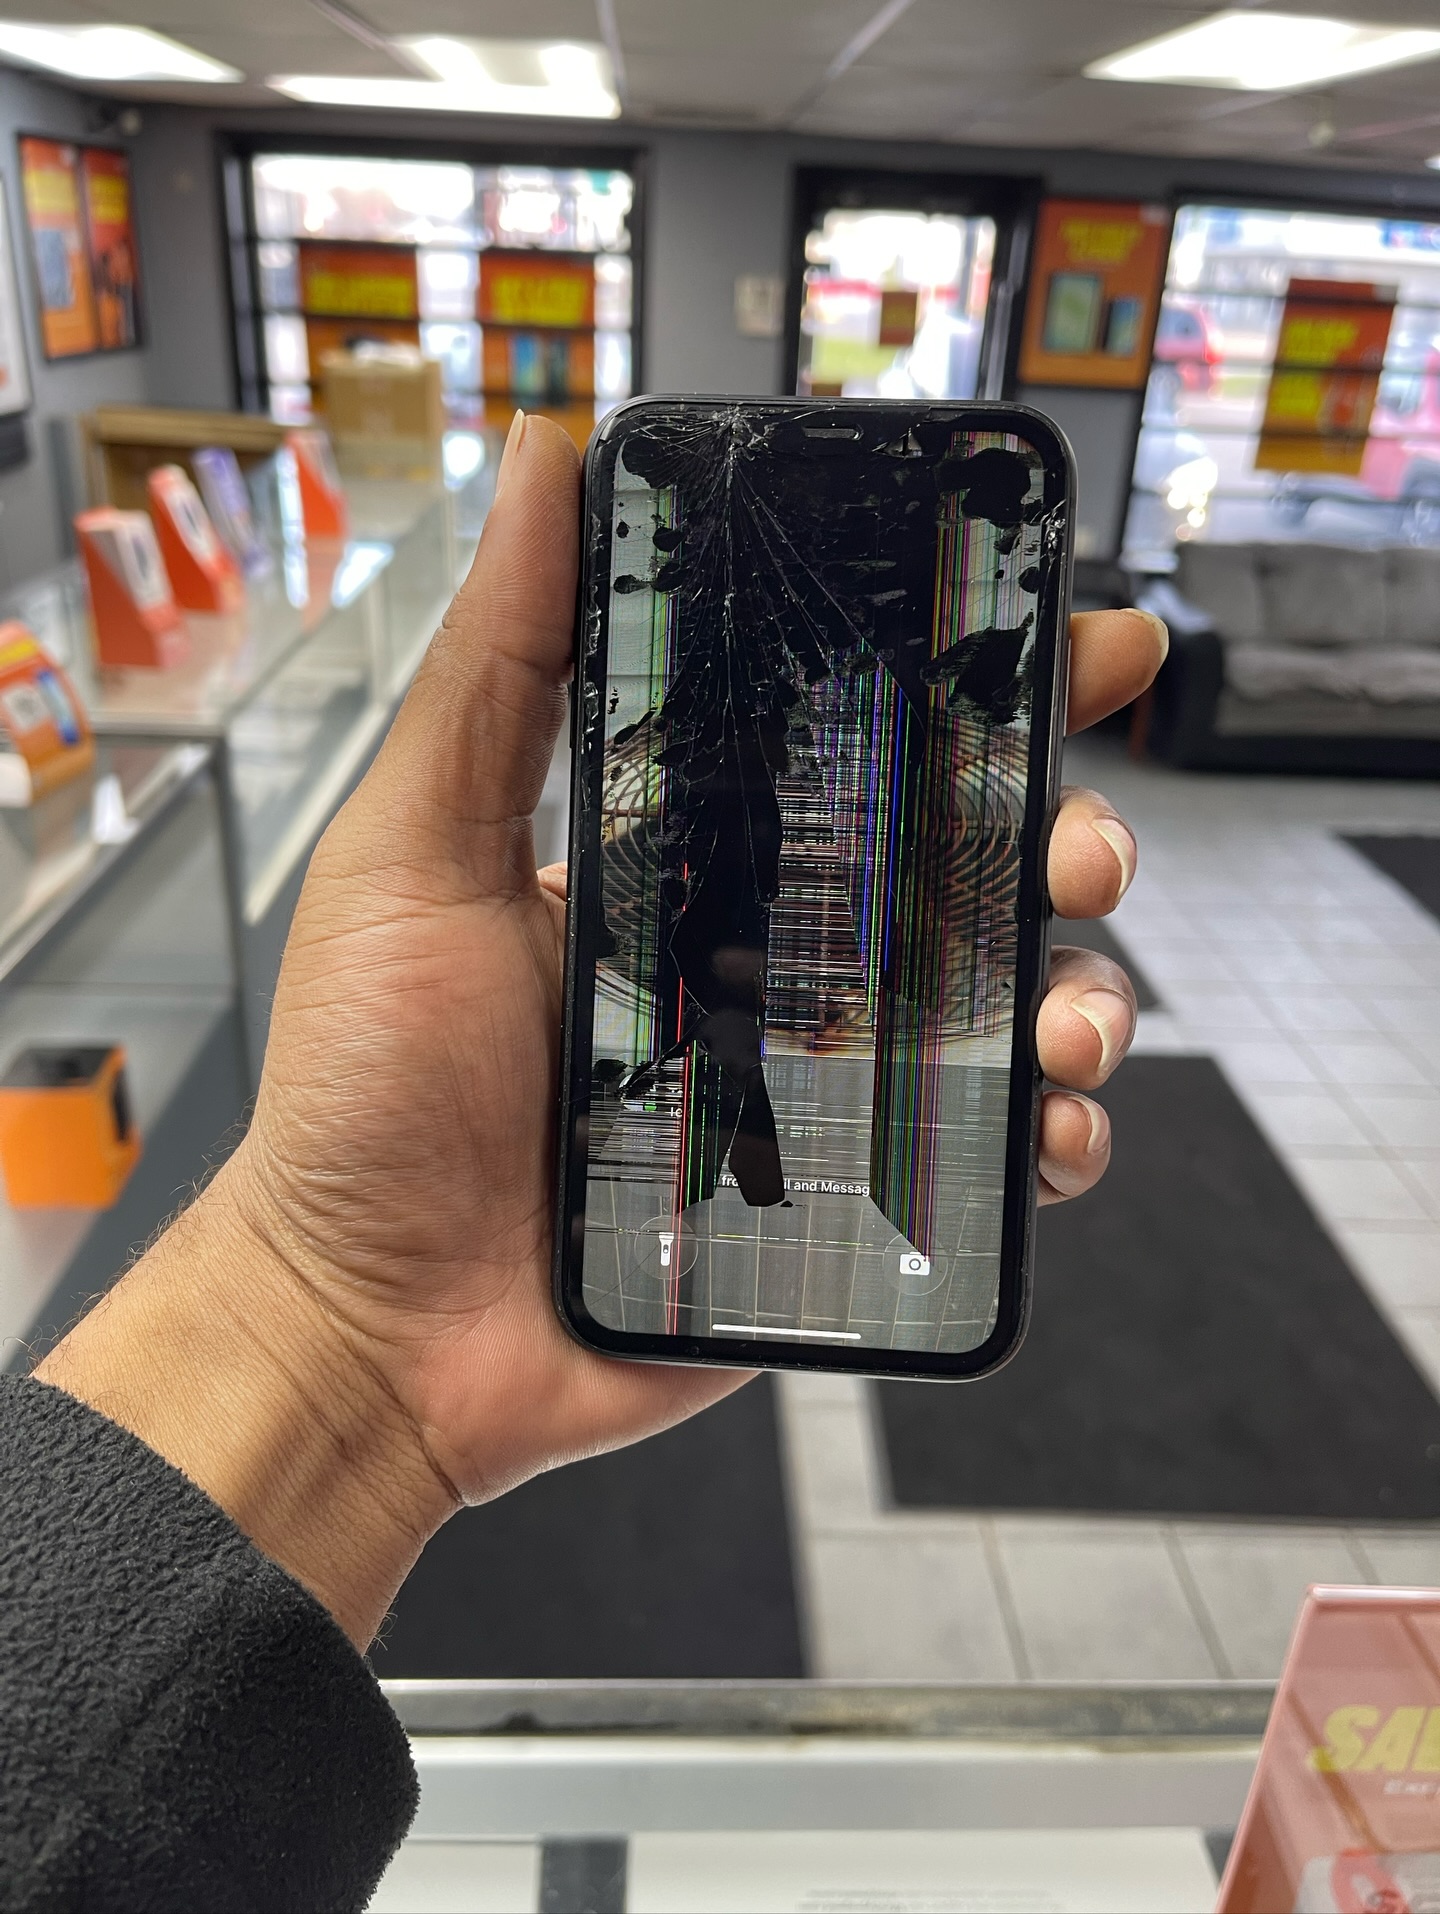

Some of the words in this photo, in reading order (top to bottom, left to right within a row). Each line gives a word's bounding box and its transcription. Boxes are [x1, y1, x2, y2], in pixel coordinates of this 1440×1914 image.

[721, 1175, 739, 1187] fro
[794, 1180, 817, 1192] and
[820, 1181, 870, 1197] Messag
